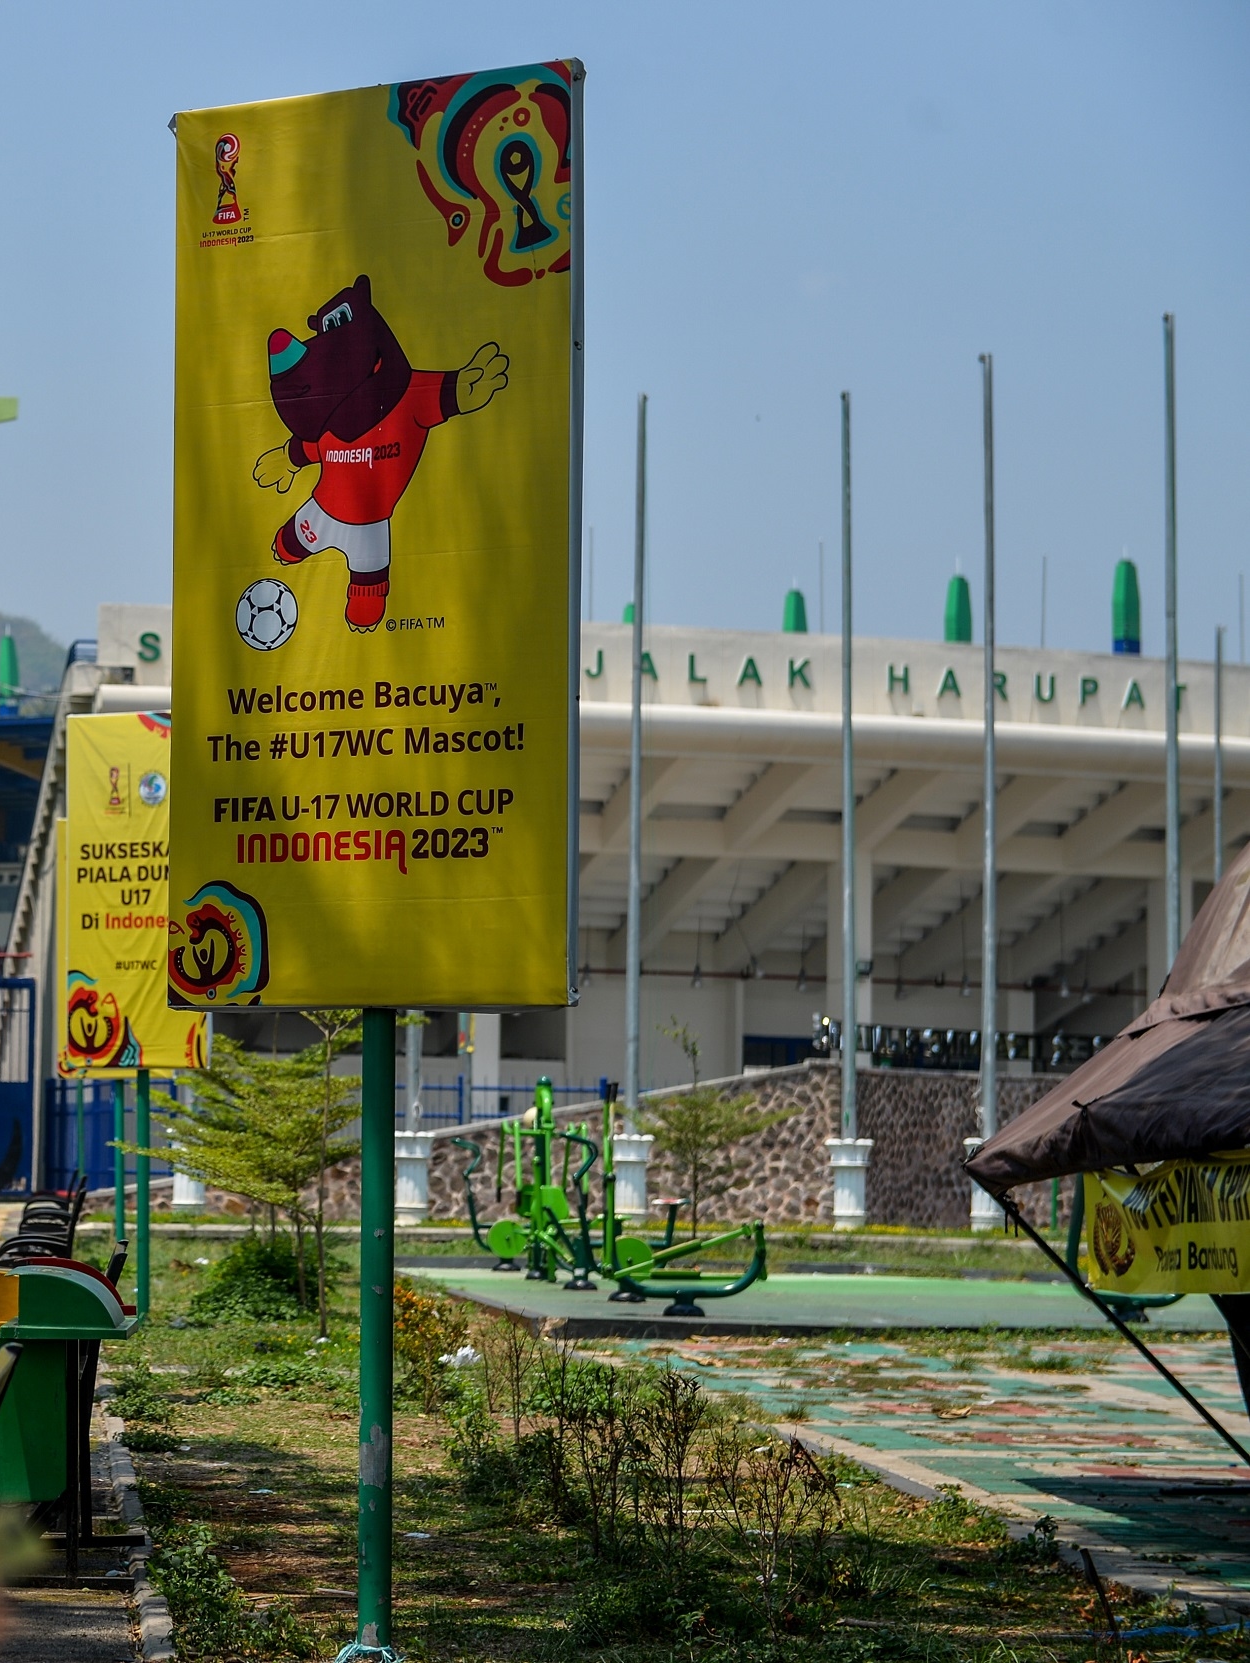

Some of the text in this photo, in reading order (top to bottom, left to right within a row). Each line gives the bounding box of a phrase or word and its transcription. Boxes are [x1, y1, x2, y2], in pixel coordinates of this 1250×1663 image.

[218, 211, 236, 220] FIFA
[199, 235, 254, 247] INDONESIA 2023
[202, 226, 252, 238] U-17 WORLD CUP
[325, 442, 401, 469] INDONESIA 2023
[299, 519, 318, 544] 23
[400, 617, 424, 631] FIFA
[427, 616, 445, 629] TM
[585, 648, 811, 688] JALAK
[886, 662, 1187, 711] HARUPAT
[228, 685, 365, 715] Welcome
[207, 723, 525, 762] The #U17WC Mascot!
[214, 788, 514, 823] FIFA U-17 WORLD CUP
[237, 829, 408, 875] INDONESIA
[77, 865, 132, 884] PIALA
[121, 888, 152, 906] U17
[81, 911, 168, 931] Di Indone
[115, 960, 157, 971] #U17WC
